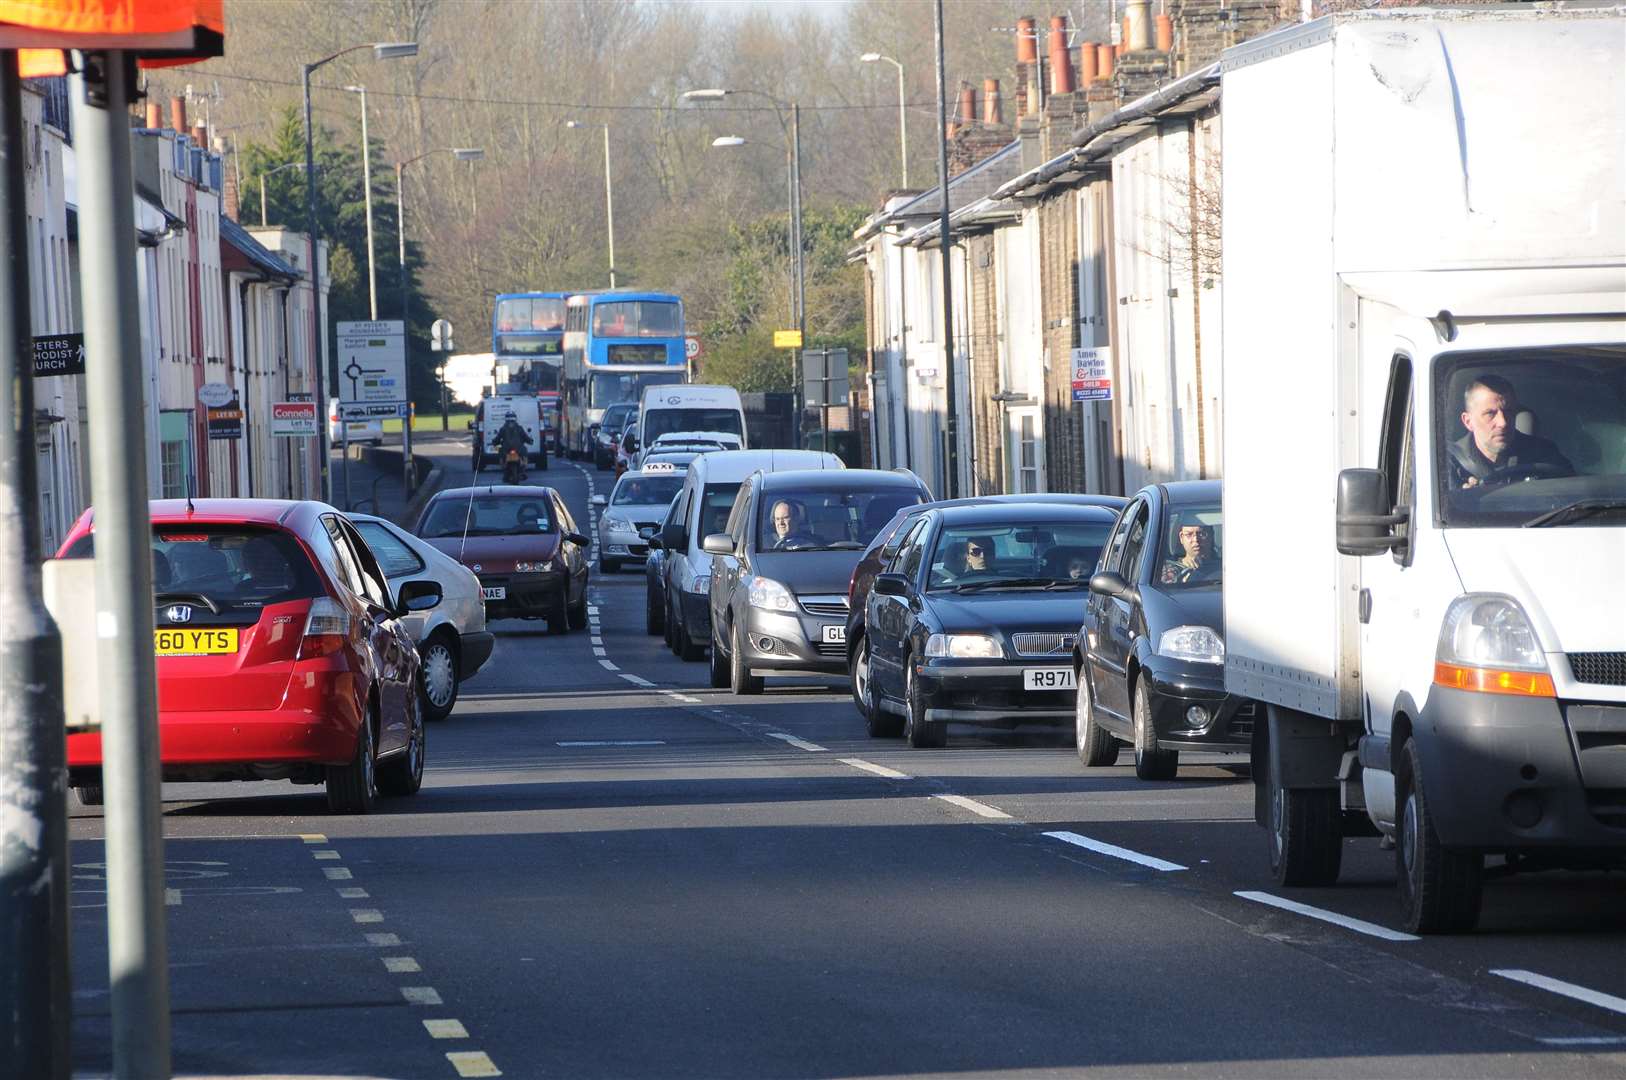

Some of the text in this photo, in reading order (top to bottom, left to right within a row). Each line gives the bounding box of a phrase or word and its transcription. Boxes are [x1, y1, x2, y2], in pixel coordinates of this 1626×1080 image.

[32, 360, 66, 370] URCH
[275, 408, 313, 418] Connells
[829, 627, 845, 640] GL
[155, 632, 229, 650] 60 YTS
[1035, 671, 1071, 687] R971
